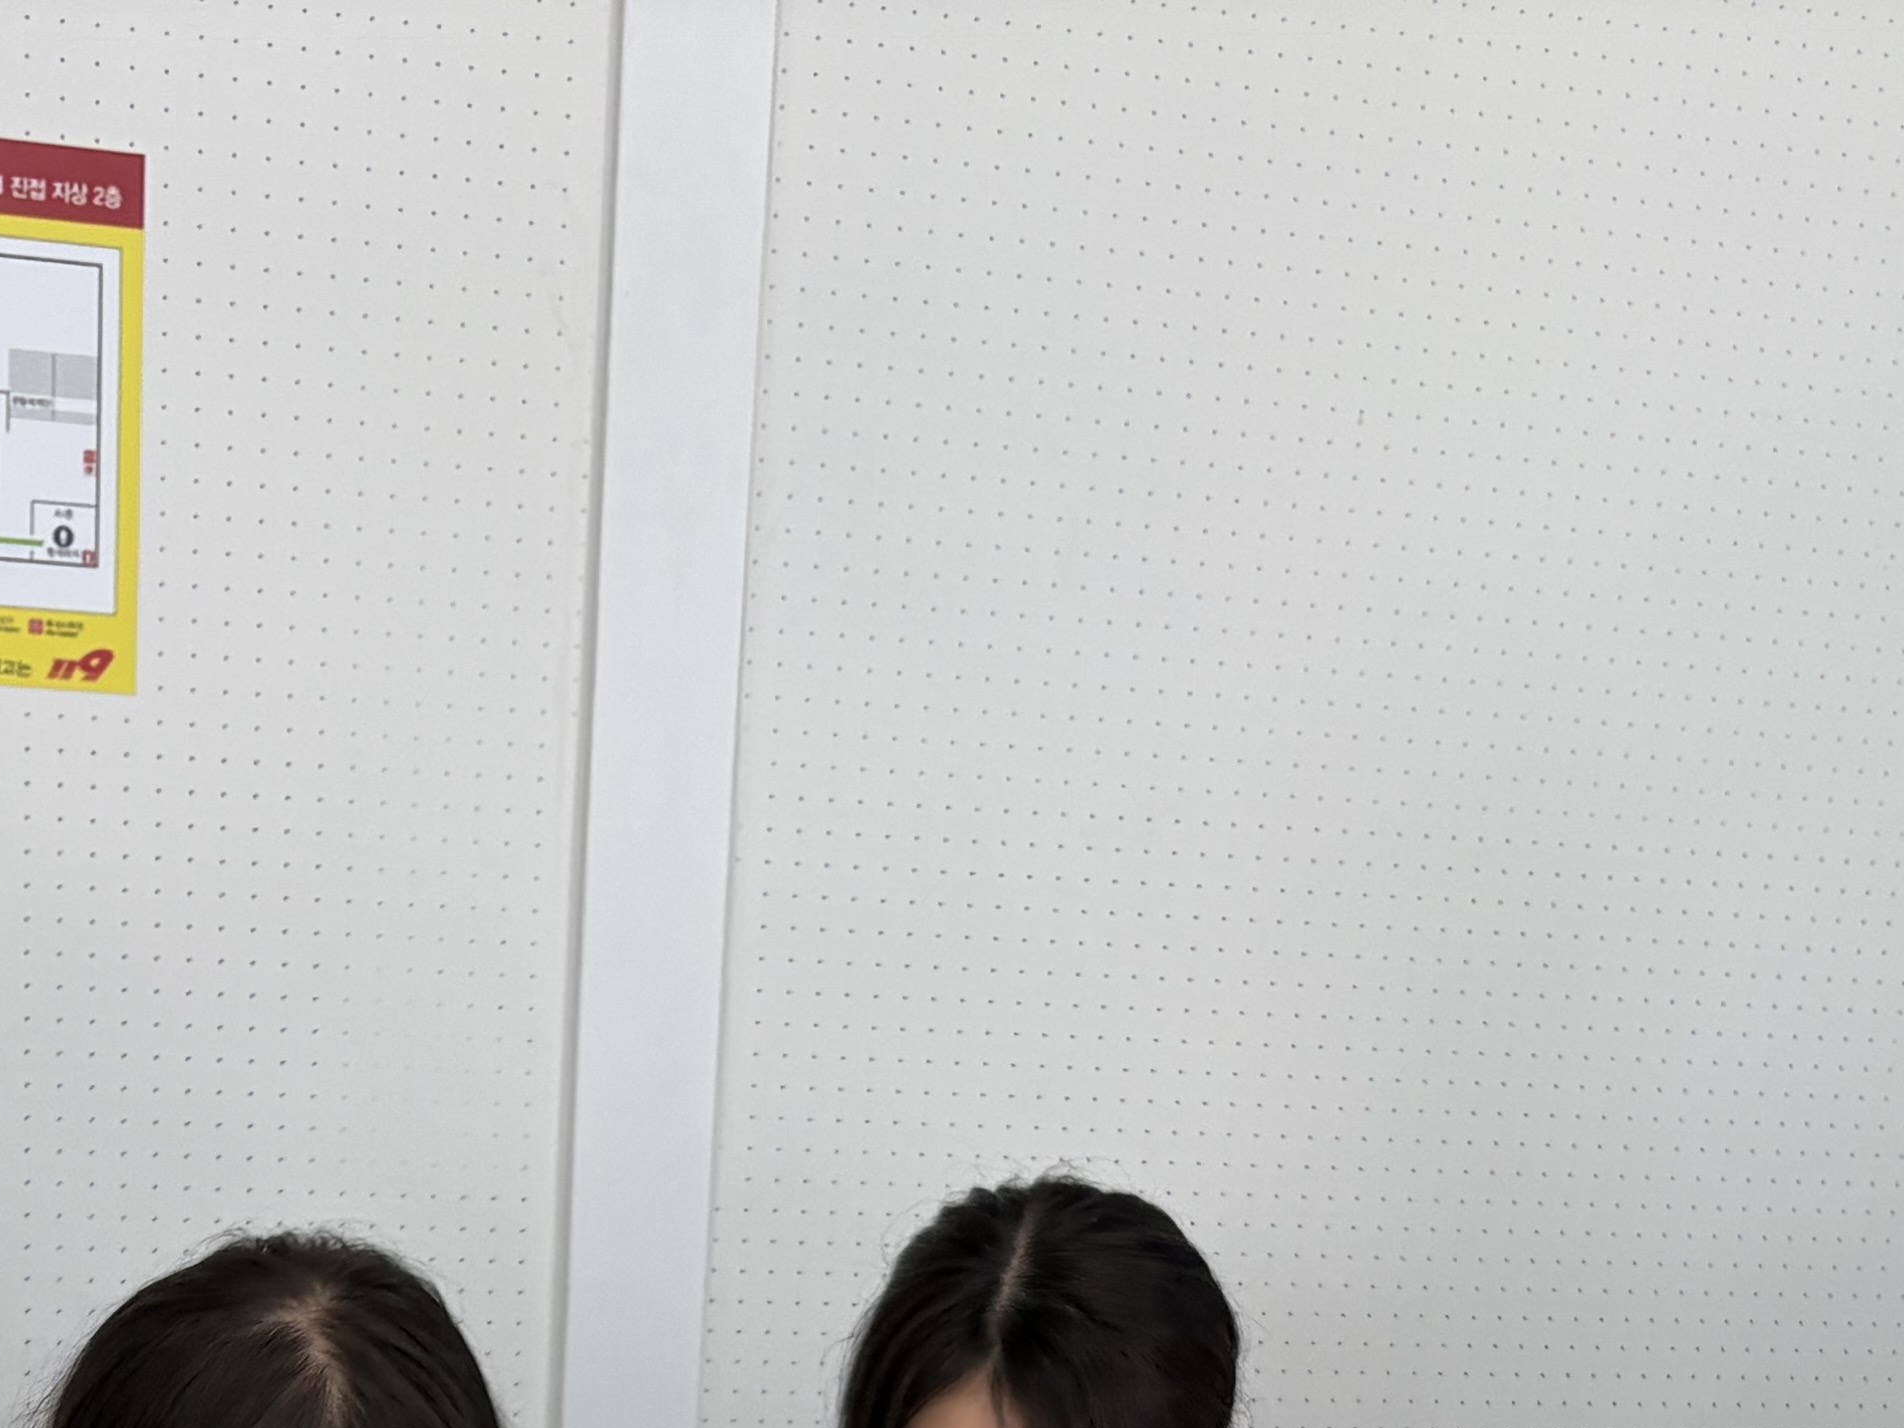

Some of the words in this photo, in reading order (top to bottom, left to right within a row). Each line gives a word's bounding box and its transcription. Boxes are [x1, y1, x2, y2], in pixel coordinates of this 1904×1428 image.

[10, 176, 46, 201] 진접
[52, 182, 87, 206] 지상
[93, 186, 122, 209] 2층
